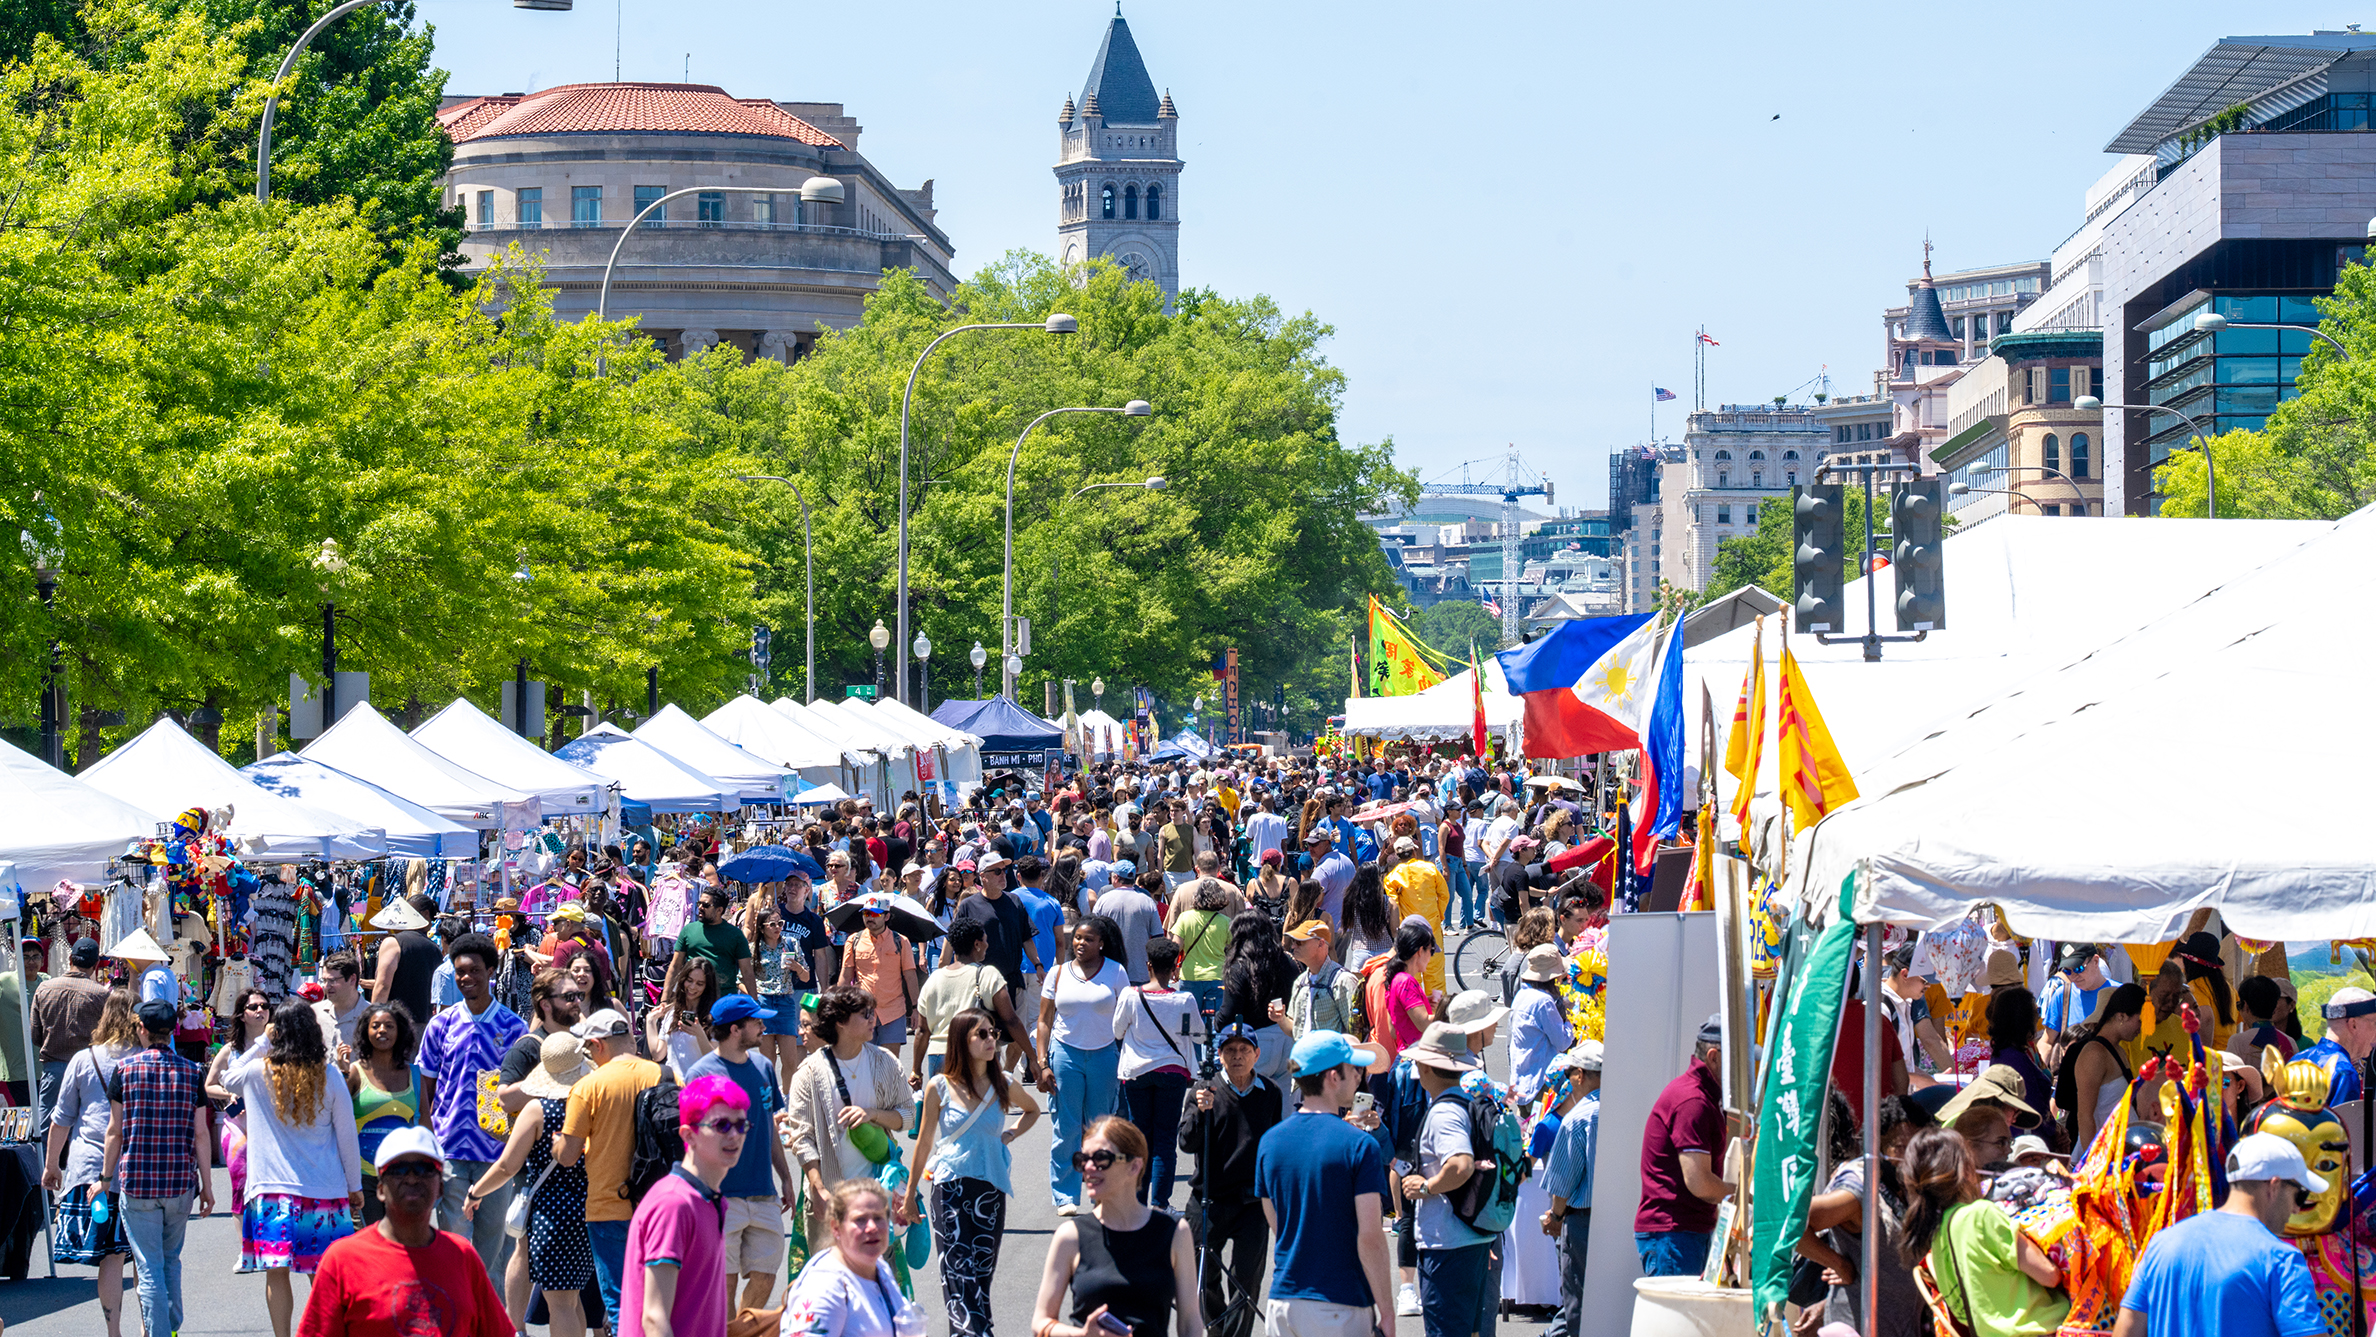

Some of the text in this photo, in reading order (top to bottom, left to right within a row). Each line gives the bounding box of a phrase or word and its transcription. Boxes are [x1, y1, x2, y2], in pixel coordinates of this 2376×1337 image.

[855, 687, 861, 695] 4
[989, 755, 1009, 766] BANH
[1011, 755, 1020, 764] MI
[1028, 754, 1043, 763] PHO
[785, 921, 811, 938] LARGO
